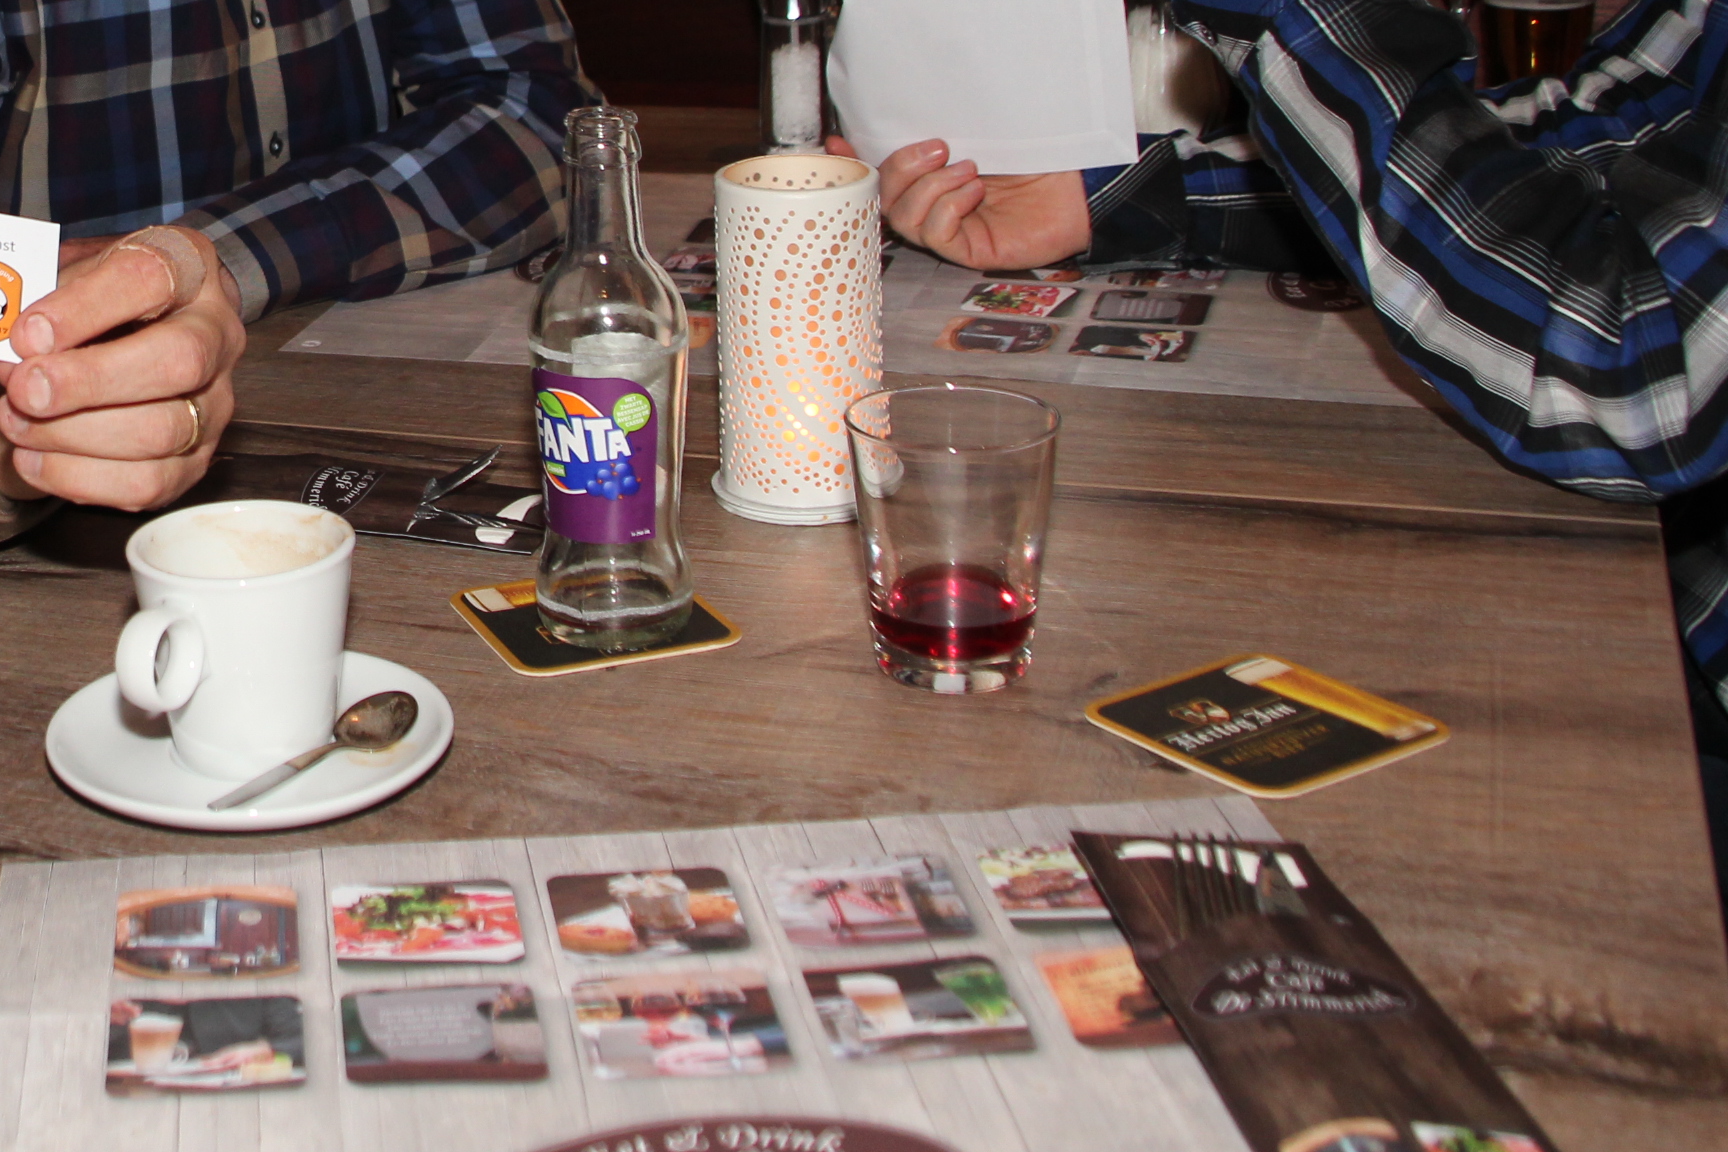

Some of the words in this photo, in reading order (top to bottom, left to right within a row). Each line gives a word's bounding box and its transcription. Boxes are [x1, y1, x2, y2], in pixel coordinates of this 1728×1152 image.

[535, 403, 632, 464] FANTA
[335, 470, 360, 490] Café
[336, 481, 368, 505] Drink
